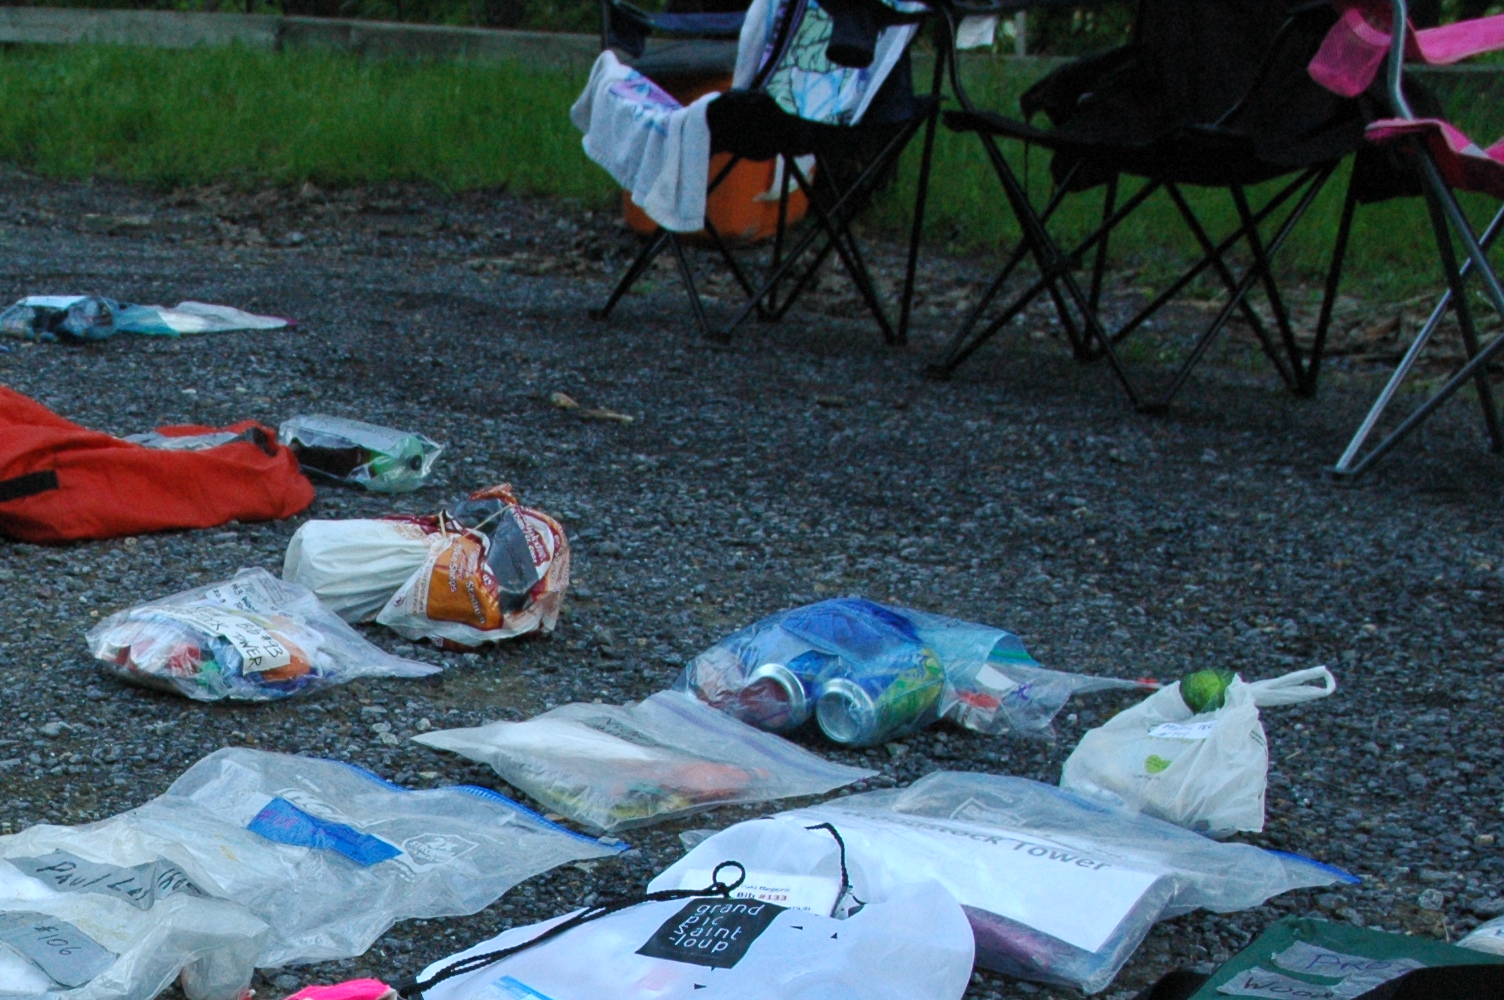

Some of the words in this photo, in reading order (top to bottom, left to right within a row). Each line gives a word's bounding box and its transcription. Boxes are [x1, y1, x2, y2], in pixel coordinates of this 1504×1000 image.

[1011, 840, 1112, 871] Tower
[695, 903, 766, 917] grand
[685, 915, 725, 927] pic
[673, 922, 743, 941] saint
